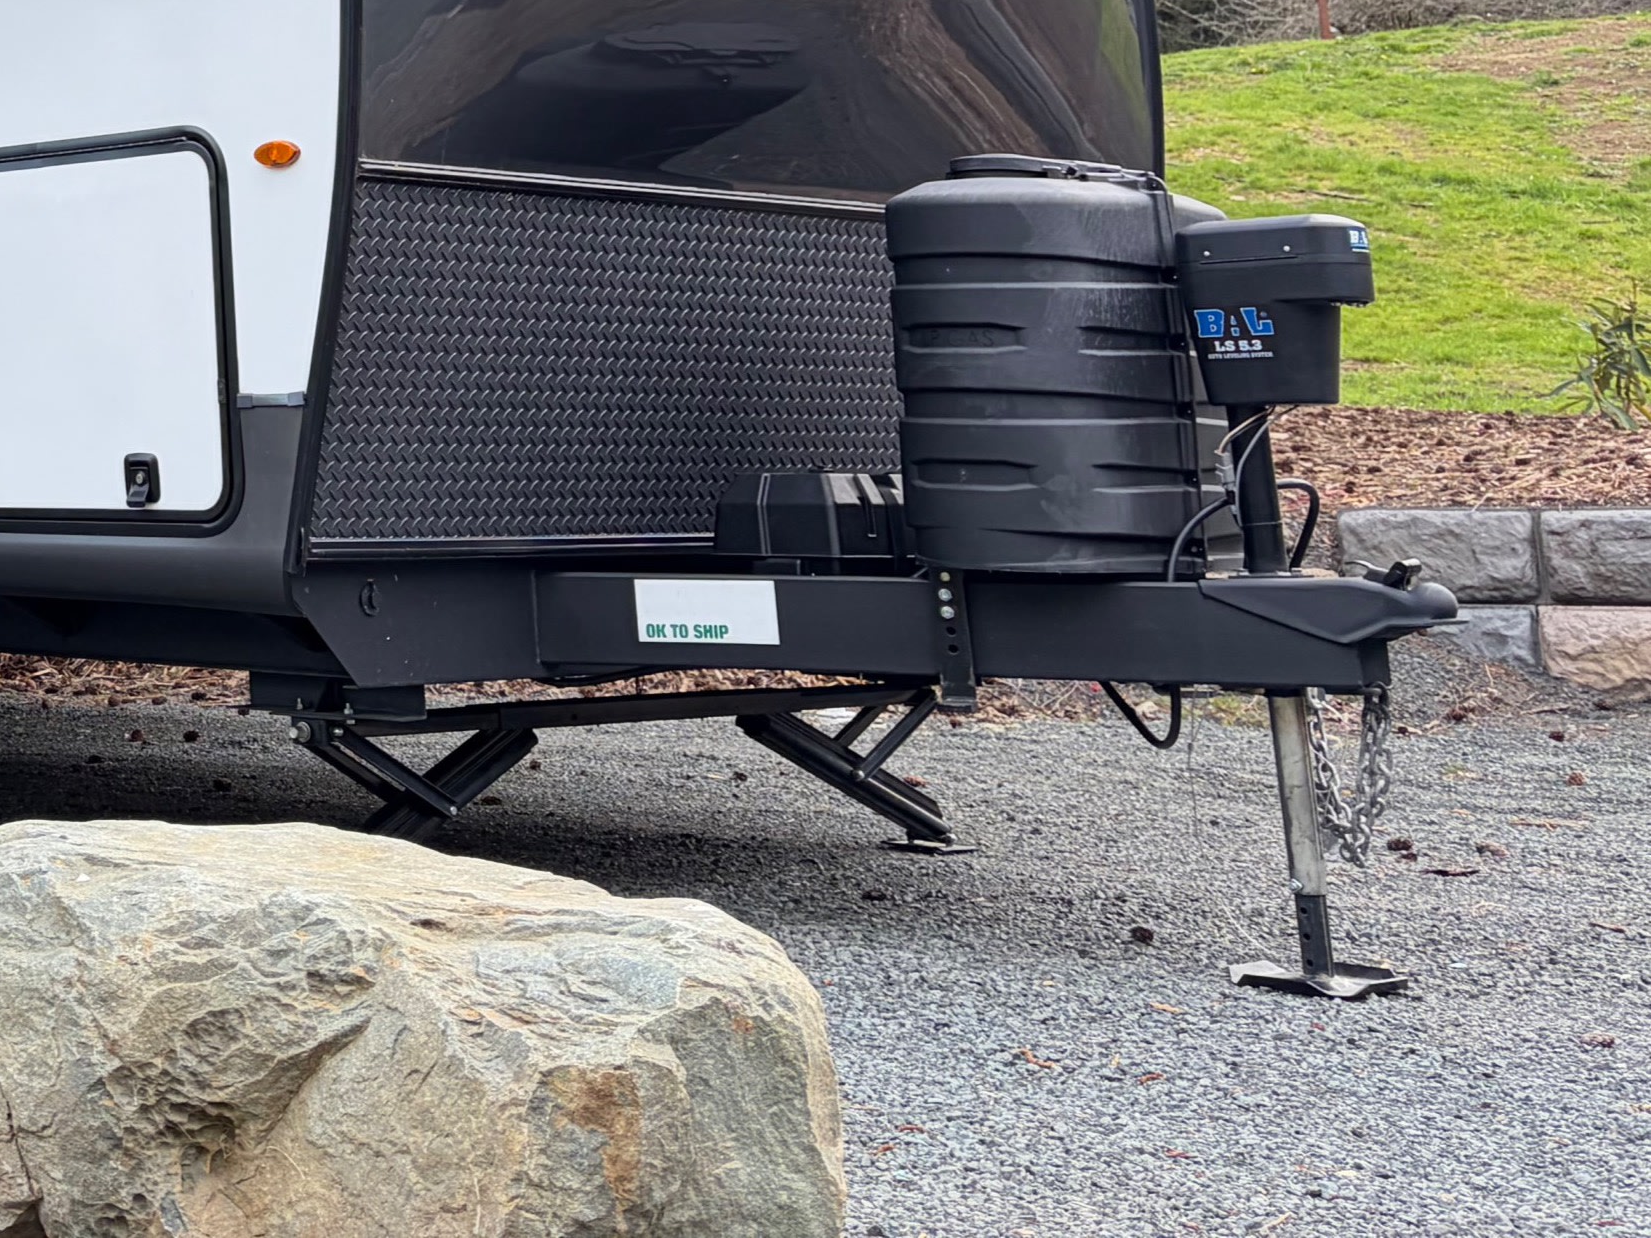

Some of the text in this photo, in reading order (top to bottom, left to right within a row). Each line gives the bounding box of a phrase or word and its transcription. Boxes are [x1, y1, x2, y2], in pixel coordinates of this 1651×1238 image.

[1193, 306, 1275, 338] BAL
[1213, 339, 1263, 352] LS 5.3
[645, 623, 730, 640] OK TO SHIP
